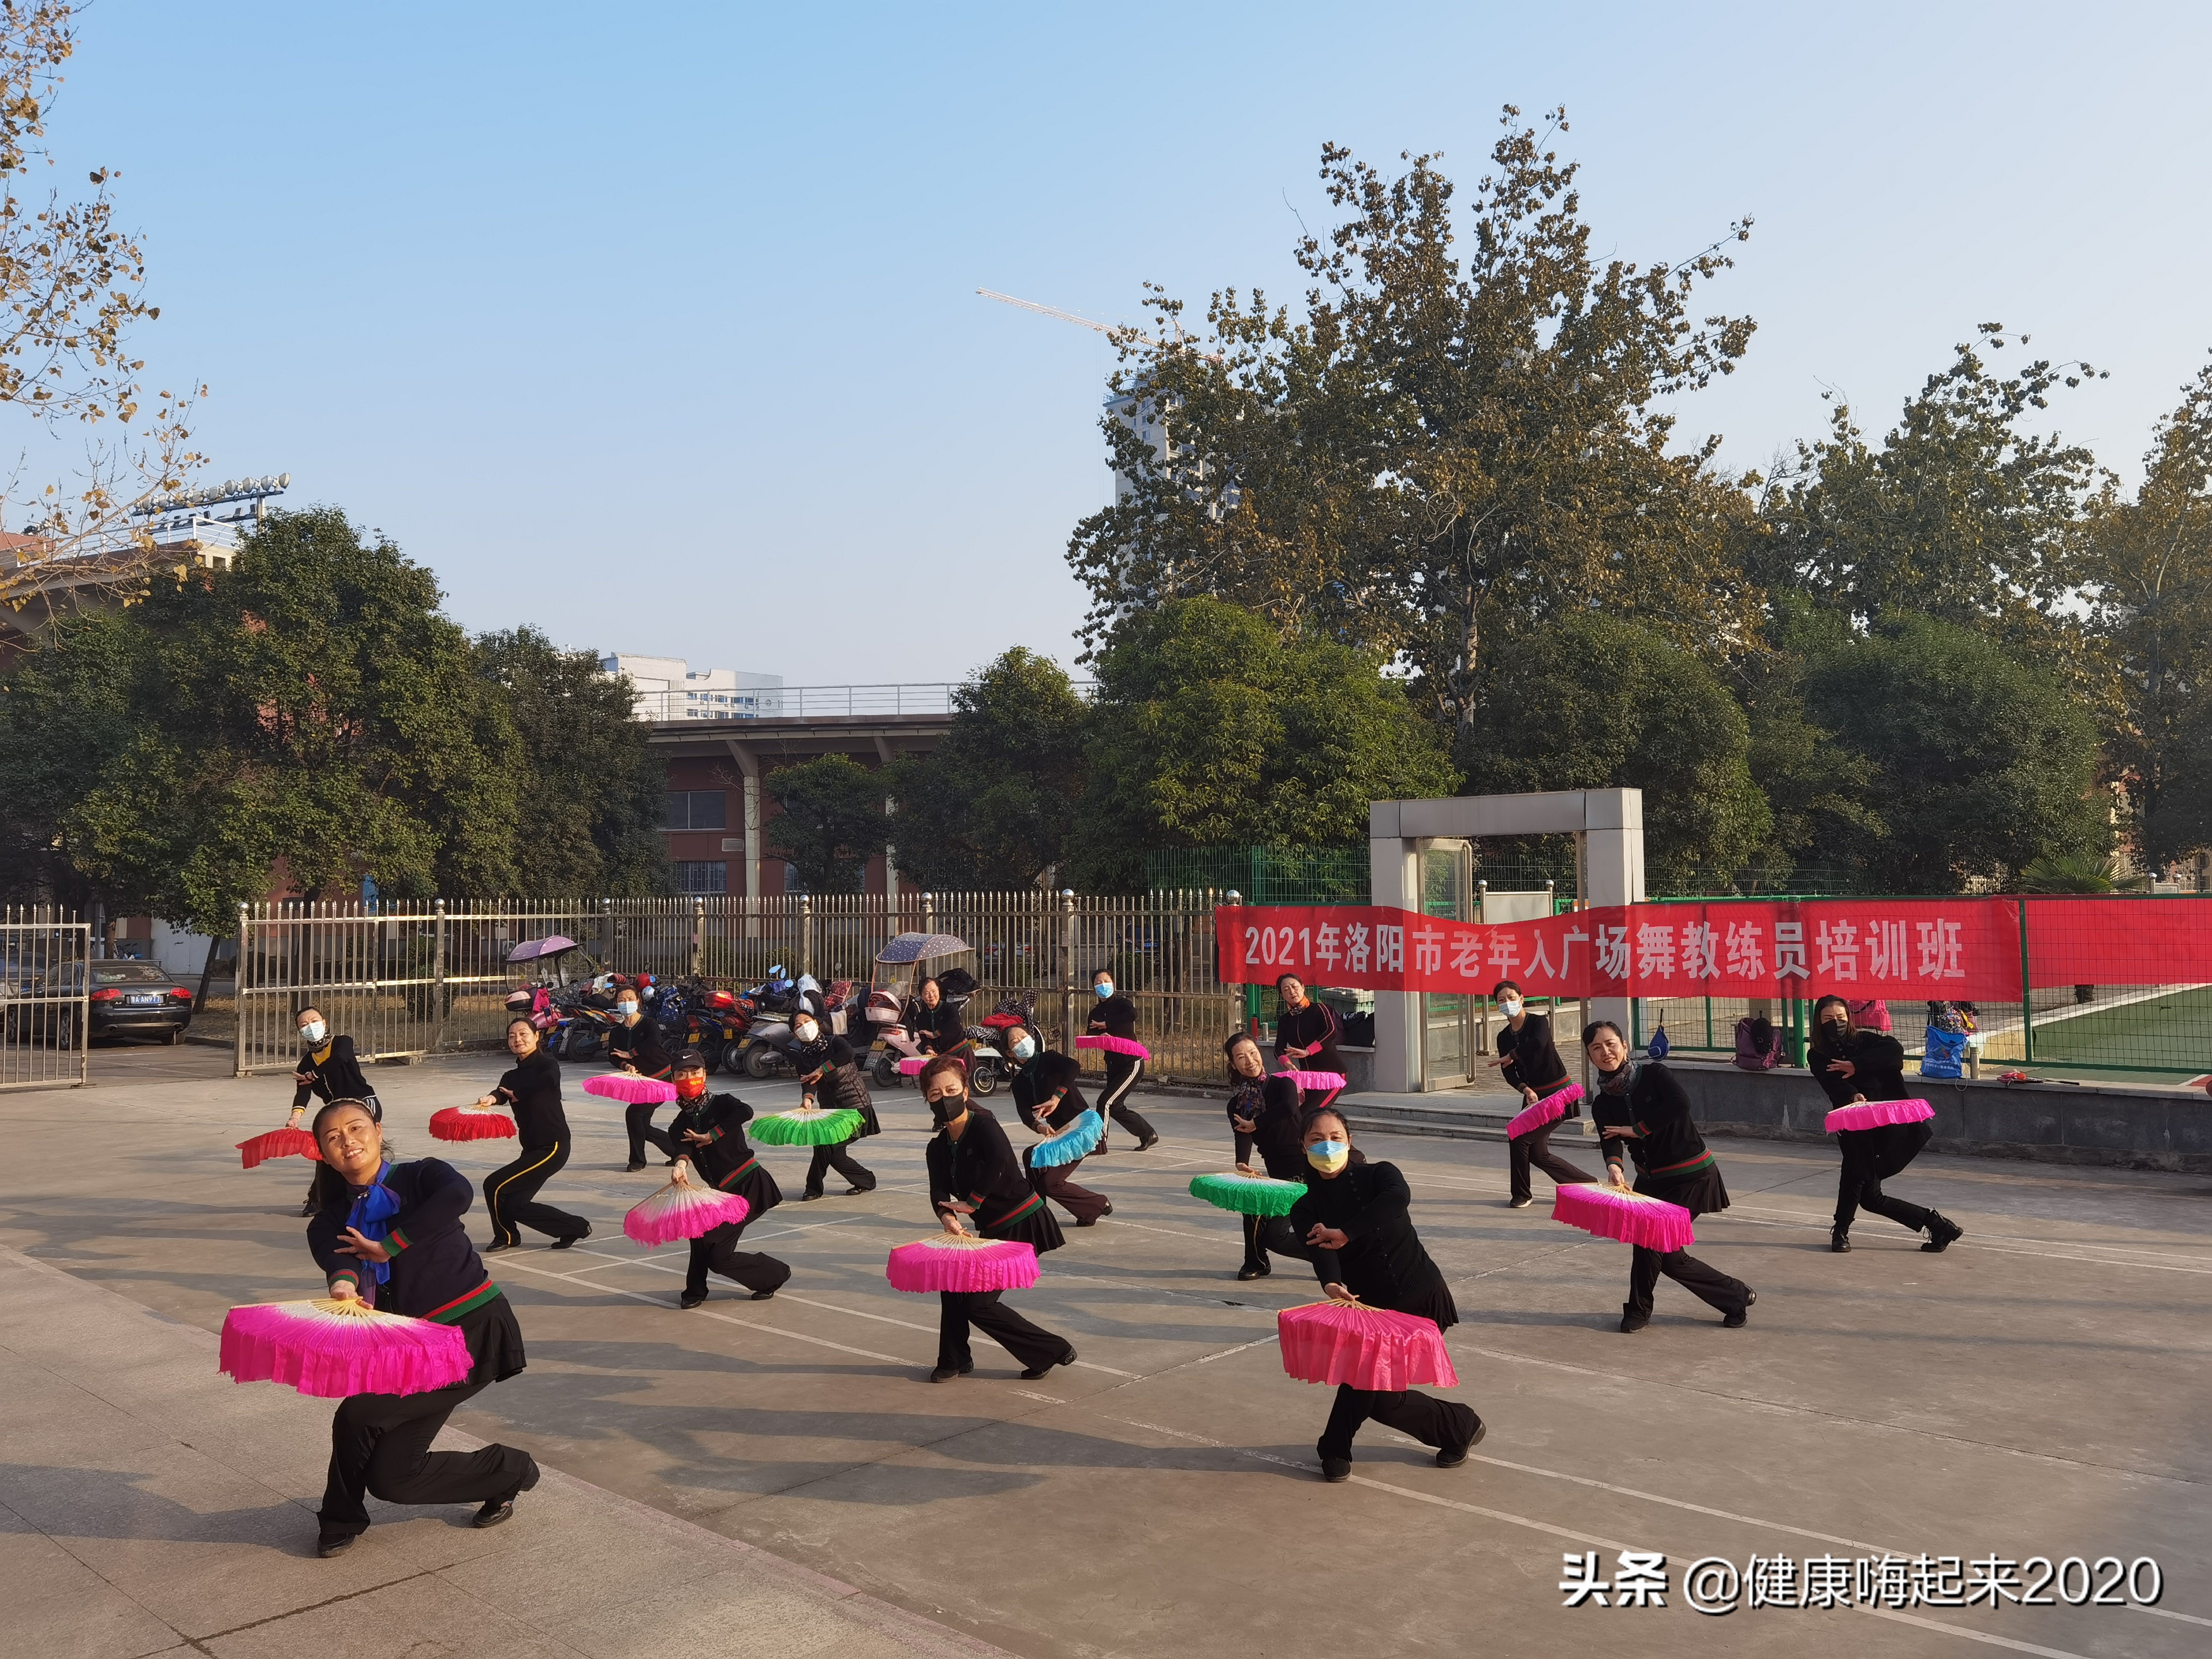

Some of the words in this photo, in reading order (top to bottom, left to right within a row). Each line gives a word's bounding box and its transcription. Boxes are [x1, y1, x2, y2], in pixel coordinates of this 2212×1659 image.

[1245, 918, 1965, 981] 2021年洛阳市老年人广场舞教练员培训班
